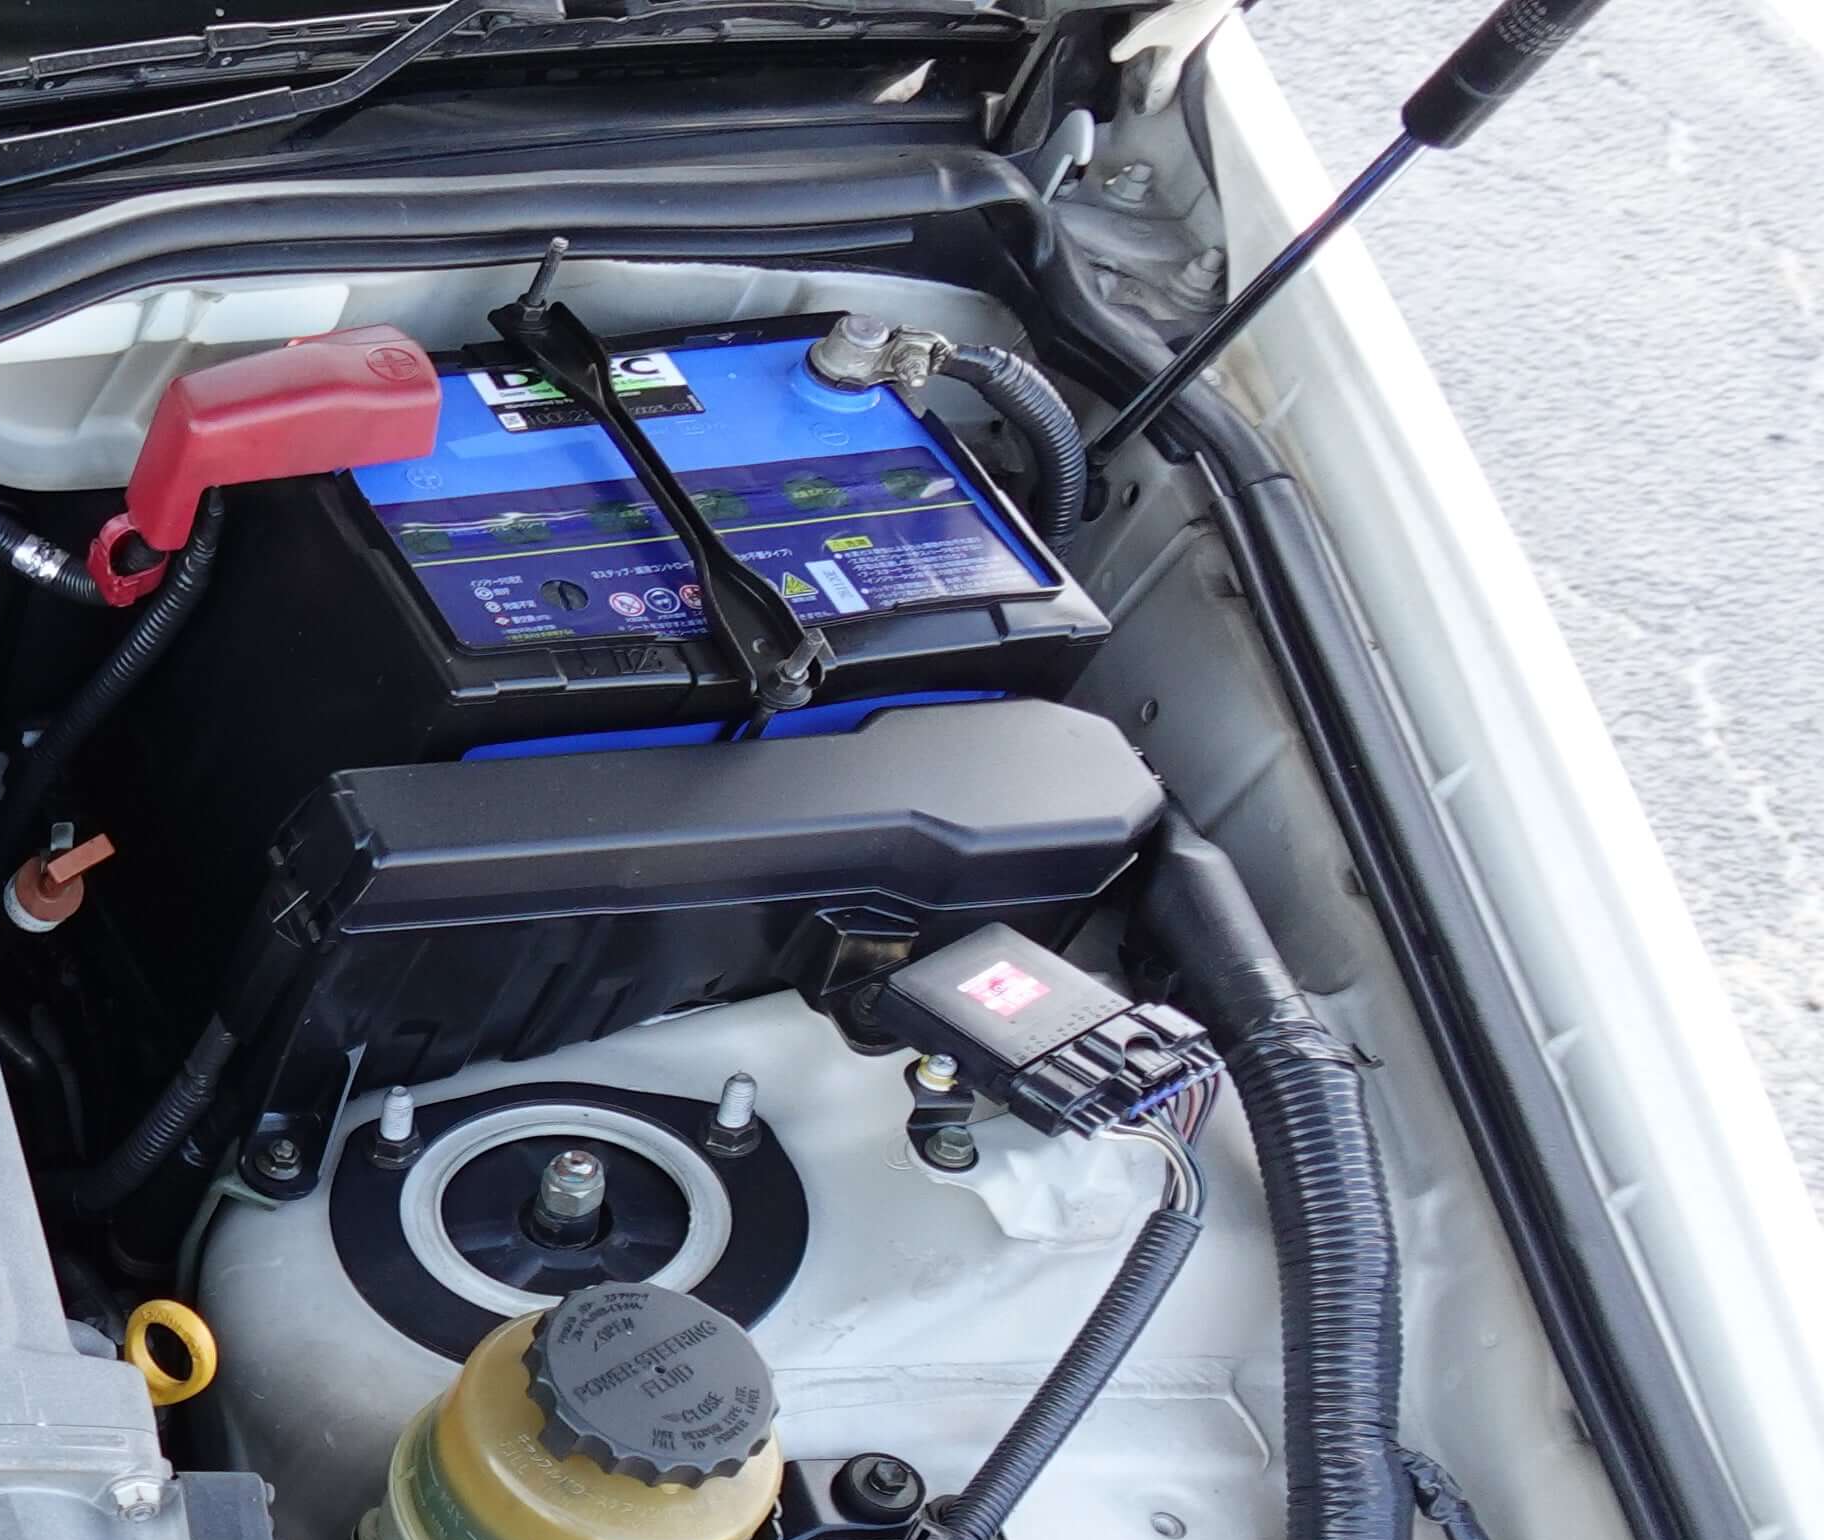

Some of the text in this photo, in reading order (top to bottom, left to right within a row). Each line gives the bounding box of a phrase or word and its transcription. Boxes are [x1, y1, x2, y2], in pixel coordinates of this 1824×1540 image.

[572, 1361, 638, 1404] POWER
[633, 1318, 719, 1371] STEERING
[640, 1362, 696, 1400] FLUID
[681, 1390, 726, 1424] CLOSE
